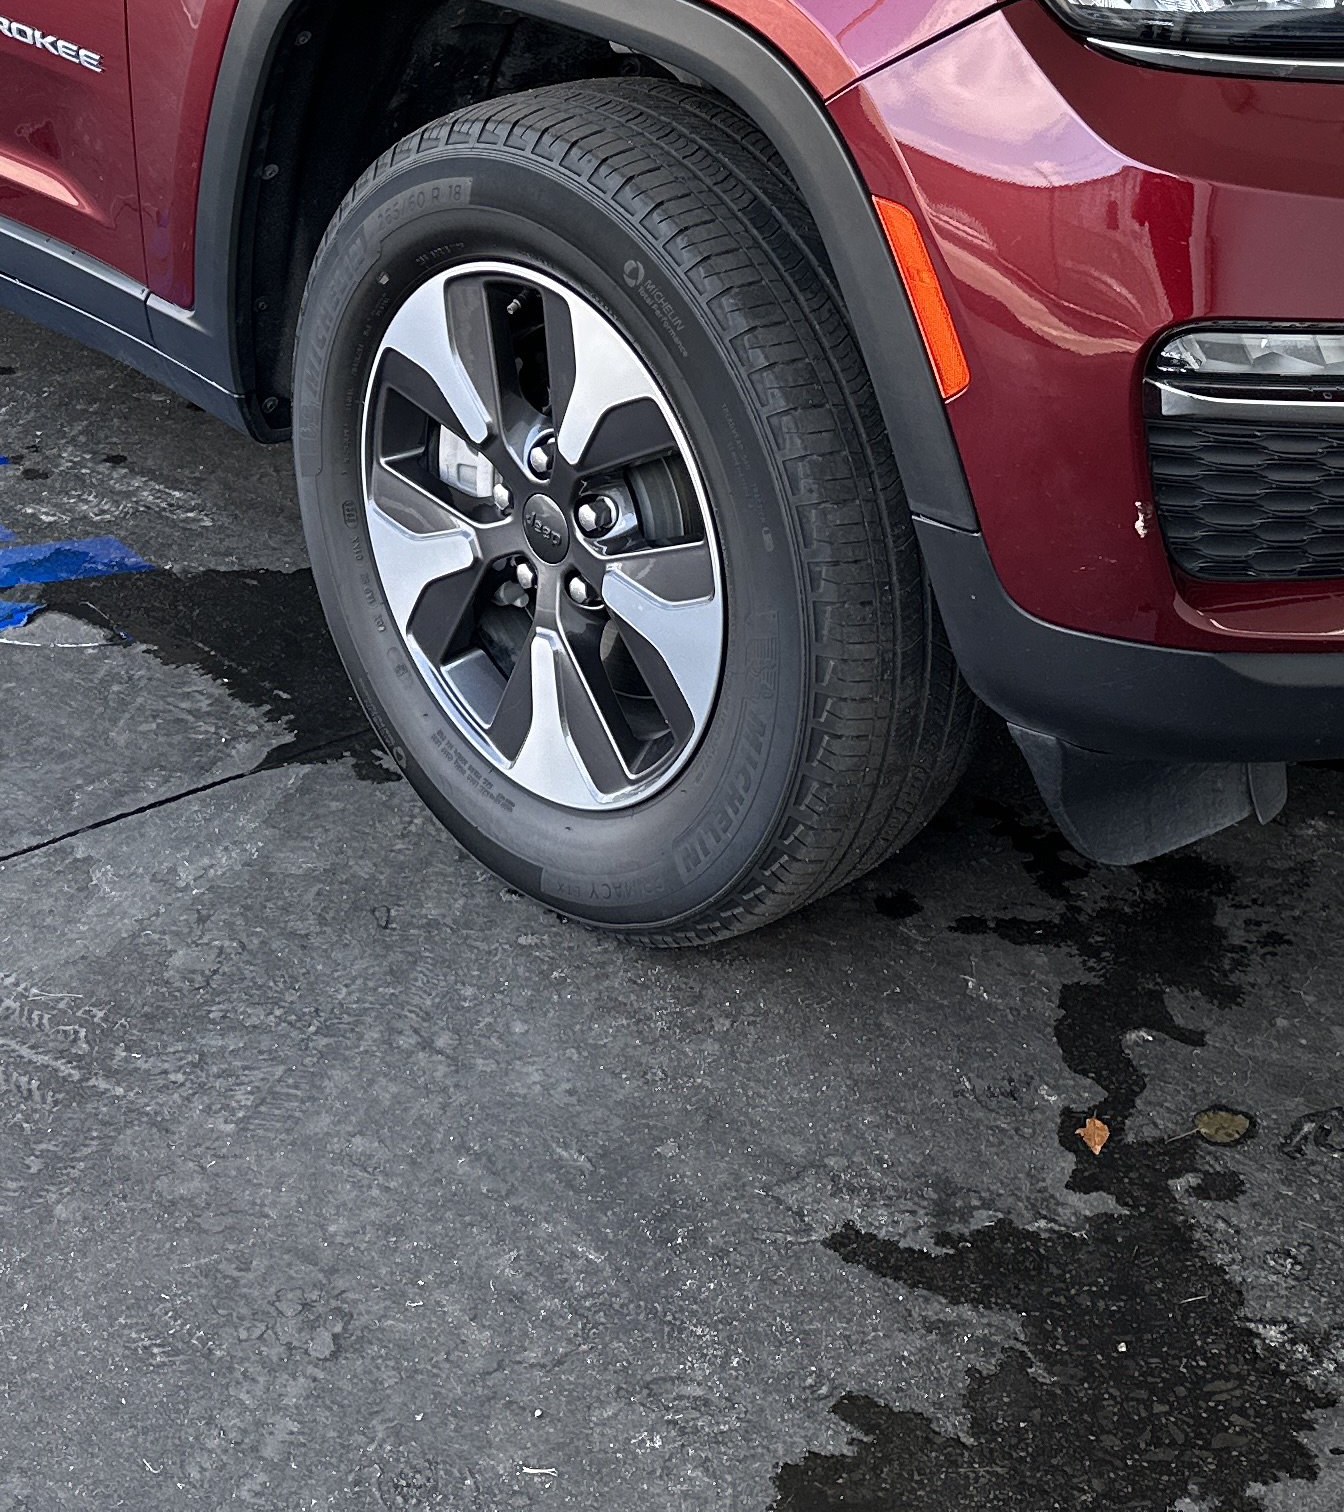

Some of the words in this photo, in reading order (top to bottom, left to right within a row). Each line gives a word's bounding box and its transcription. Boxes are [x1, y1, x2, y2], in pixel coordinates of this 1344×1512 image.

[638, 285, 655, 306] Total
[644, 279, 685, 331] MICHELIN
[525, 511, 561, 546] Jeep
[678, 709, 766, 874] MICHELIN
